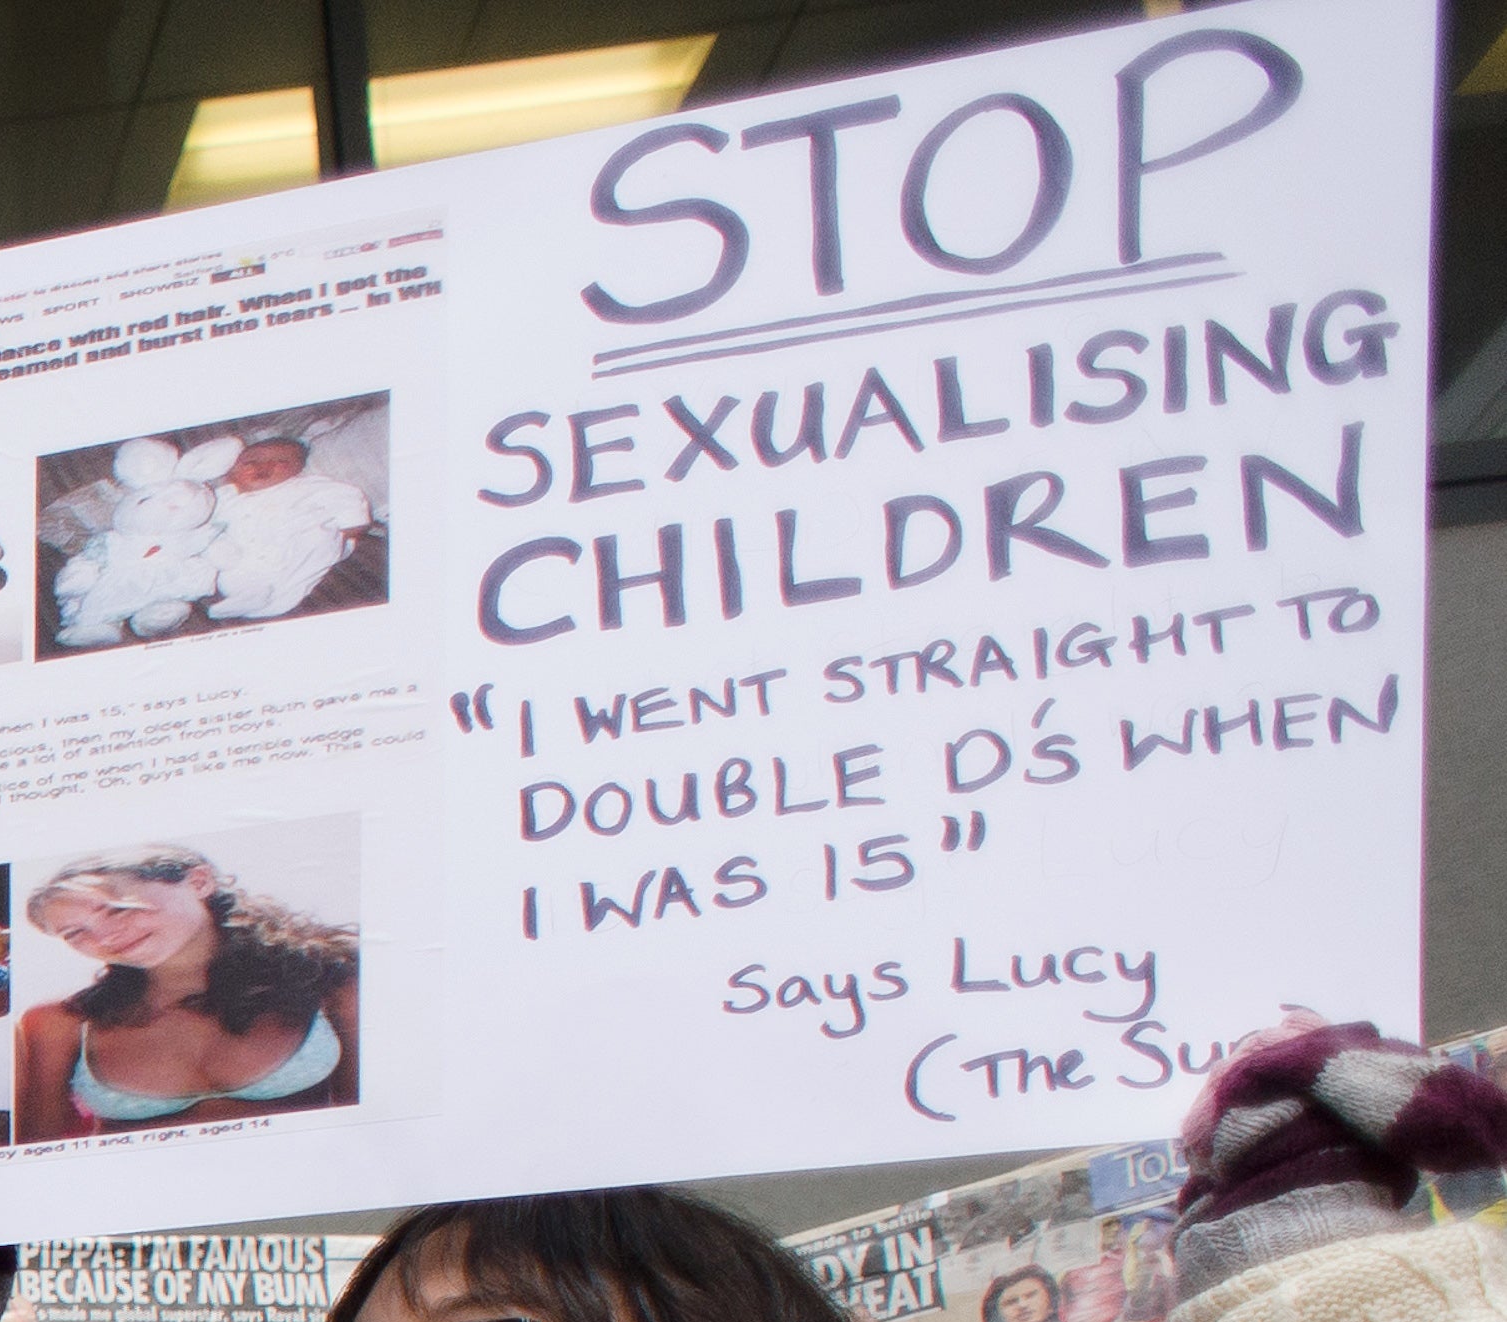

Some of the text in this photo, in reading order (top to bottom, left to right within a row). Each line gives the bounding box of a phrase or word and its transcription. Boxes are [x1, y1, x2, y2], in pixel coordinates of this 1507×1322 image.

[580, 28, 1304, 324] STOP
[68, 327, 120, 348] with
[127, 314, 168, 335] red
[239, 287, 312, 313] When
[336, 273, 378, 296] got
[385, 265, 428, 284] the
[85, 341, 131, 364] and
[137, 328, 203, 353] burst
[210, 317, 259, 338] into
[267, 302, 333, 326] tears
[478, 289, 1399, 508] SEXUALISING
[478, 421, 1364, 645] CHILDREN
[575, 664, 786, 747] WENT
[824, 604, 1256, 706] STRAIGHT
[1278, 586, 1382, 641] TO
[518, 742, 884, 842] DOUBLE
[1121, 673, 1399, 771] WHEN
[522, 884, 539, 941] I
[580, 853, 768, 938] WAS
[952, 936, 1157, 1023] Lucy
[1117, 1021, 1236, 1090] Su
[18, 1268, 327, 1308] BECAUSE OF MY BUM
[189, 1234, 324, 1273] FAMOUS
